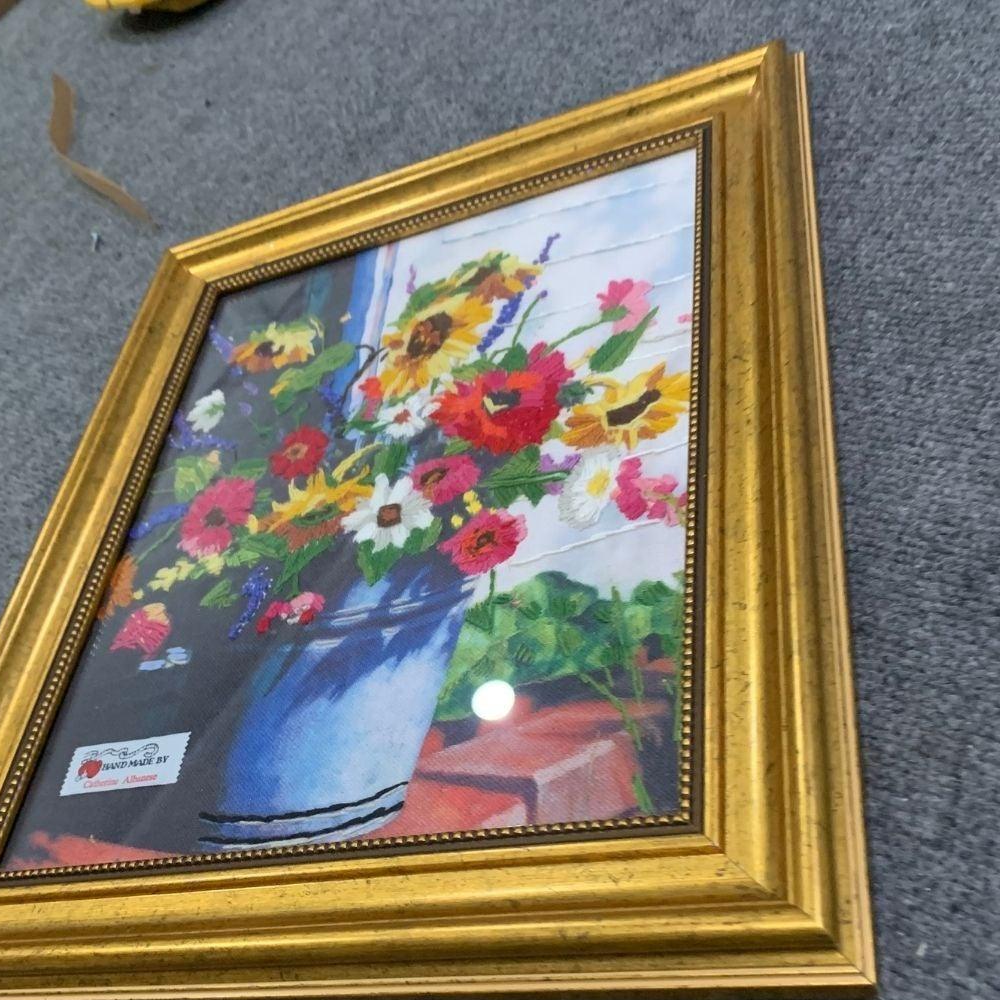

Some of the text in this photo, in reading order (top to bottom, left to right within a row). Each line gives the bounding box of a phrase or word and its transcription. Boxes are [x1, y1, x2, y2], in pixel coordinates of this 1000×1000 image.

[102, 755, 169, 771] HAND MADE BY
